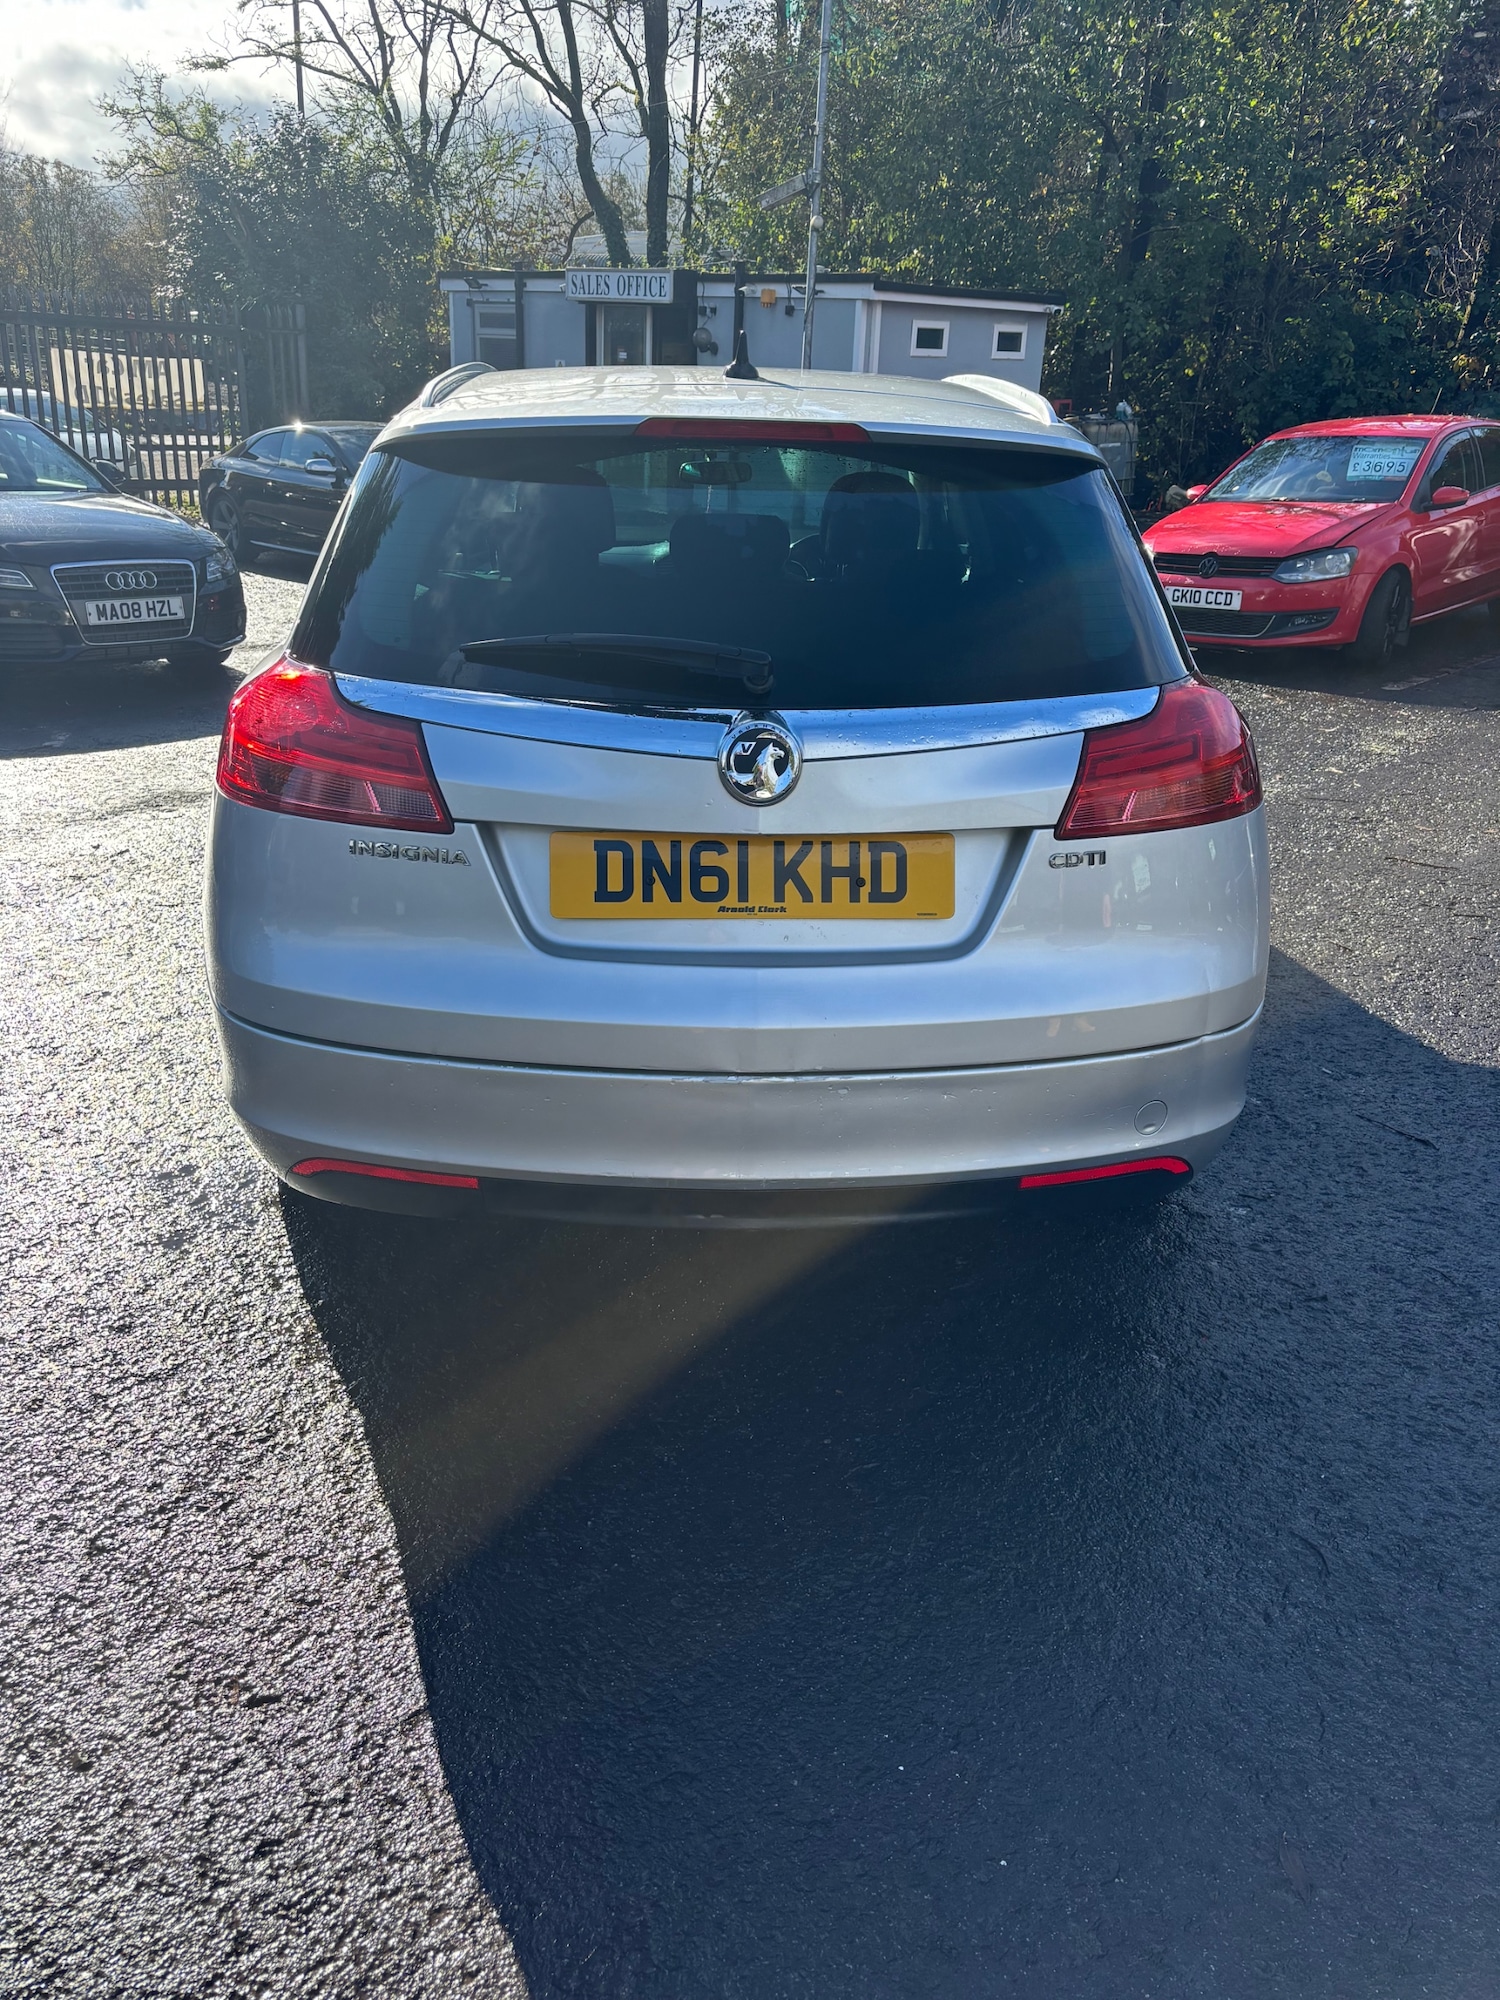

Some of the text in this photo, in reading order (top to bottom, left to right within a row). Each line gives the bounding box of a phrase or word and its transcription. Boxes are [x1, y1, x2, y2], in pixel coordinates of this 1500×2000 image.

[571, 274, 667, 298] SALES OFFICE
[1172, 588, 1234, 606] GK10 CCD
[95, 599, 178, 621] MA08 HZL
[348, 838, 472, 866] INSIGNIA
[593, 839, 908, 904] DN61 KHD
[717, 905, 787, 913] Arnold Clark
